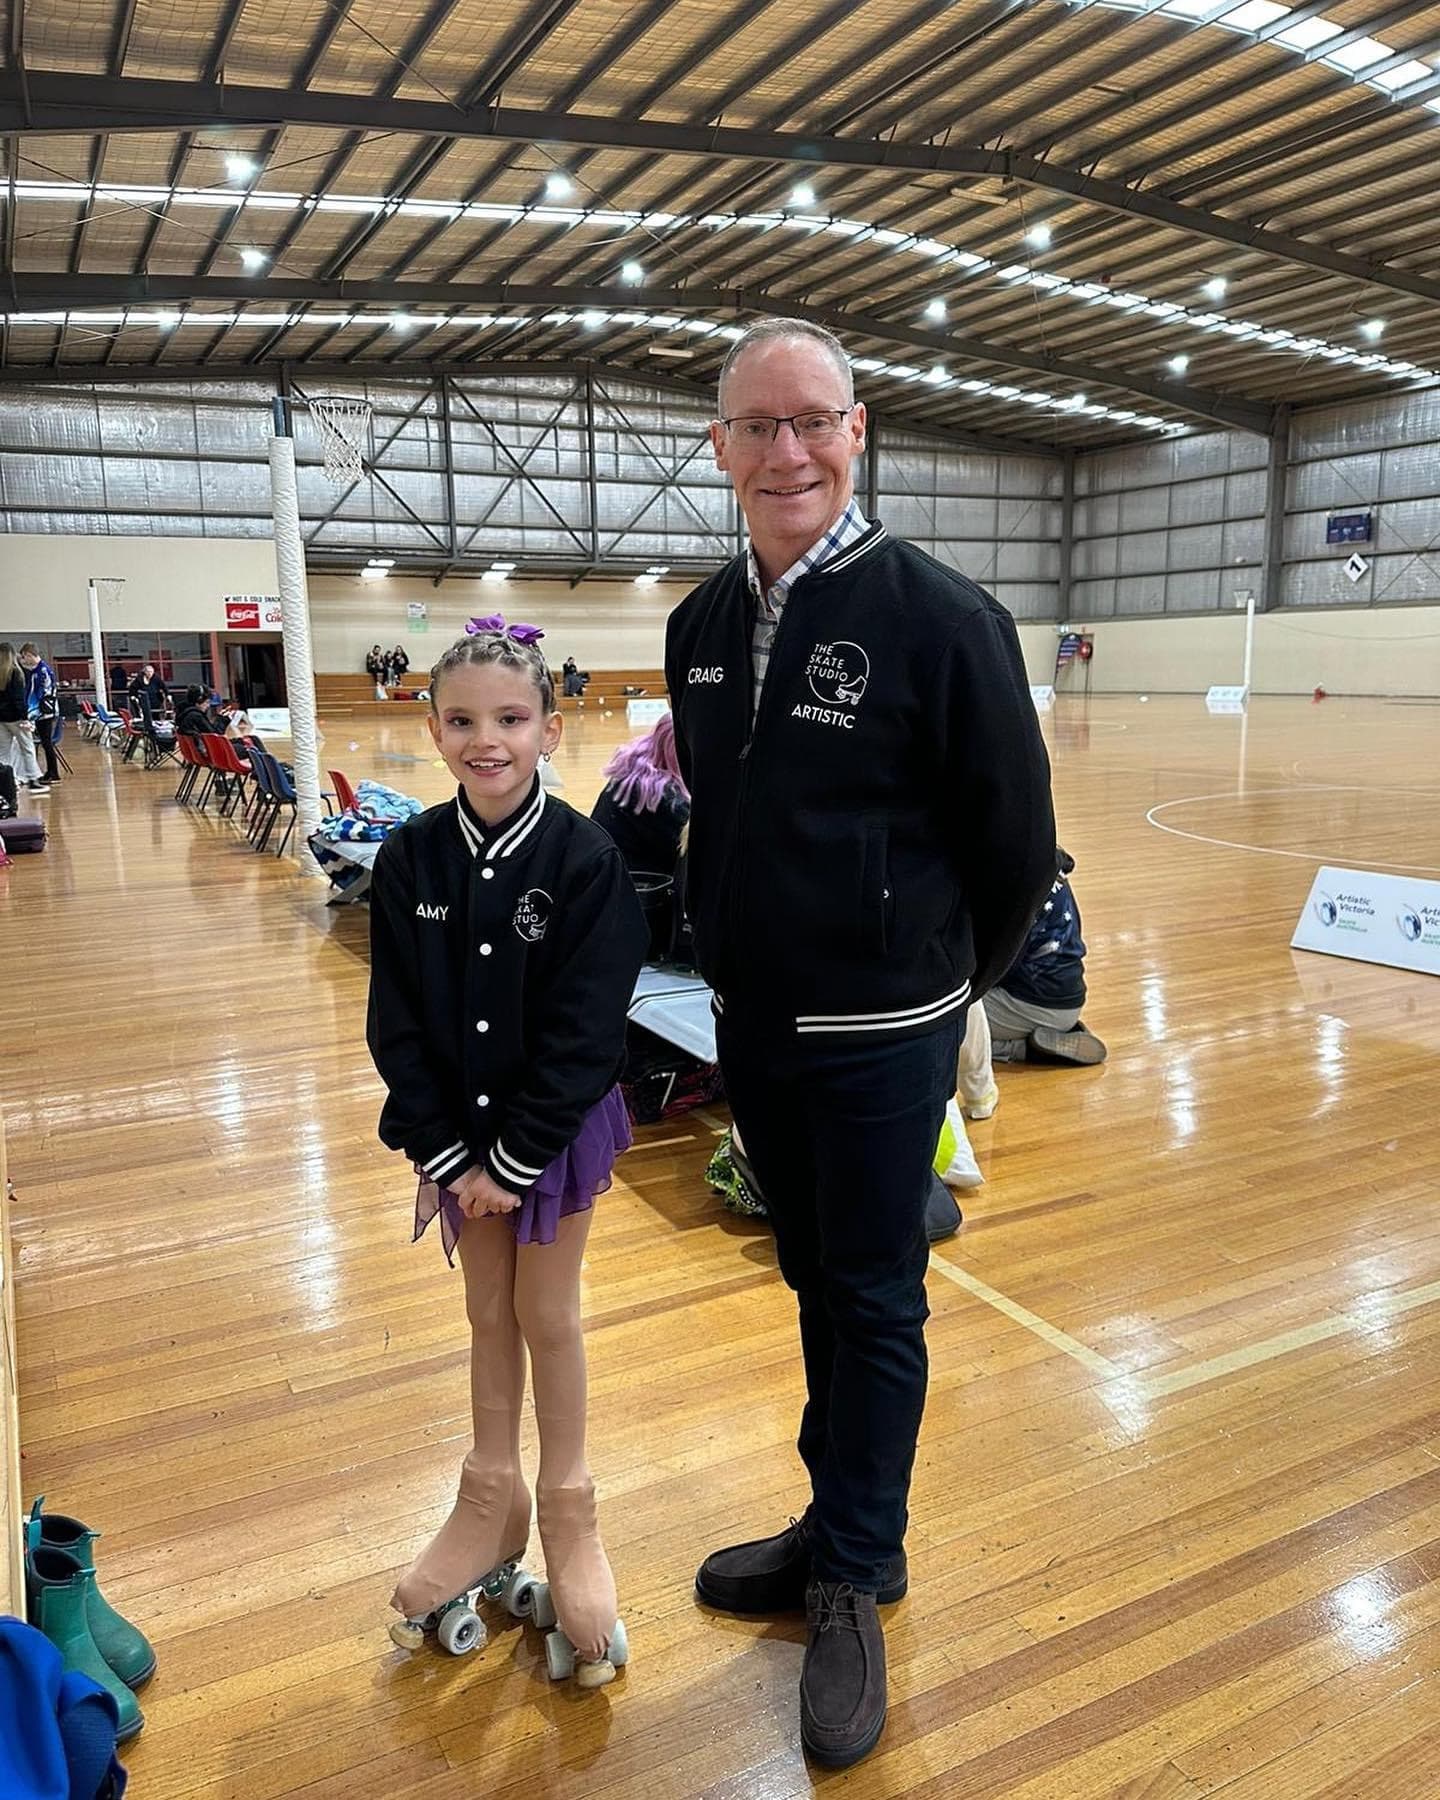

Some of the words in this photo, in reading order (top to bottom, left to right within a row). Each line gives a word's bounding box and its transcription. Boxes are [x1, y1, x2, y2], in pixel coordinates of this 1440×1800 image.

[814, 643, 834, 655] THE
[809, 654, 845, 669] SKATE
[688, 666, 724, 684] CRAIG
[805, 665, 848, 682] STUDIO
[791, 703, 856, 729] ARTISTIC
[1336, 894, 1371, 906] Artistic
[416, 902, 449, 921] AMY
[1339, 903, 1375, 916] Victoria
